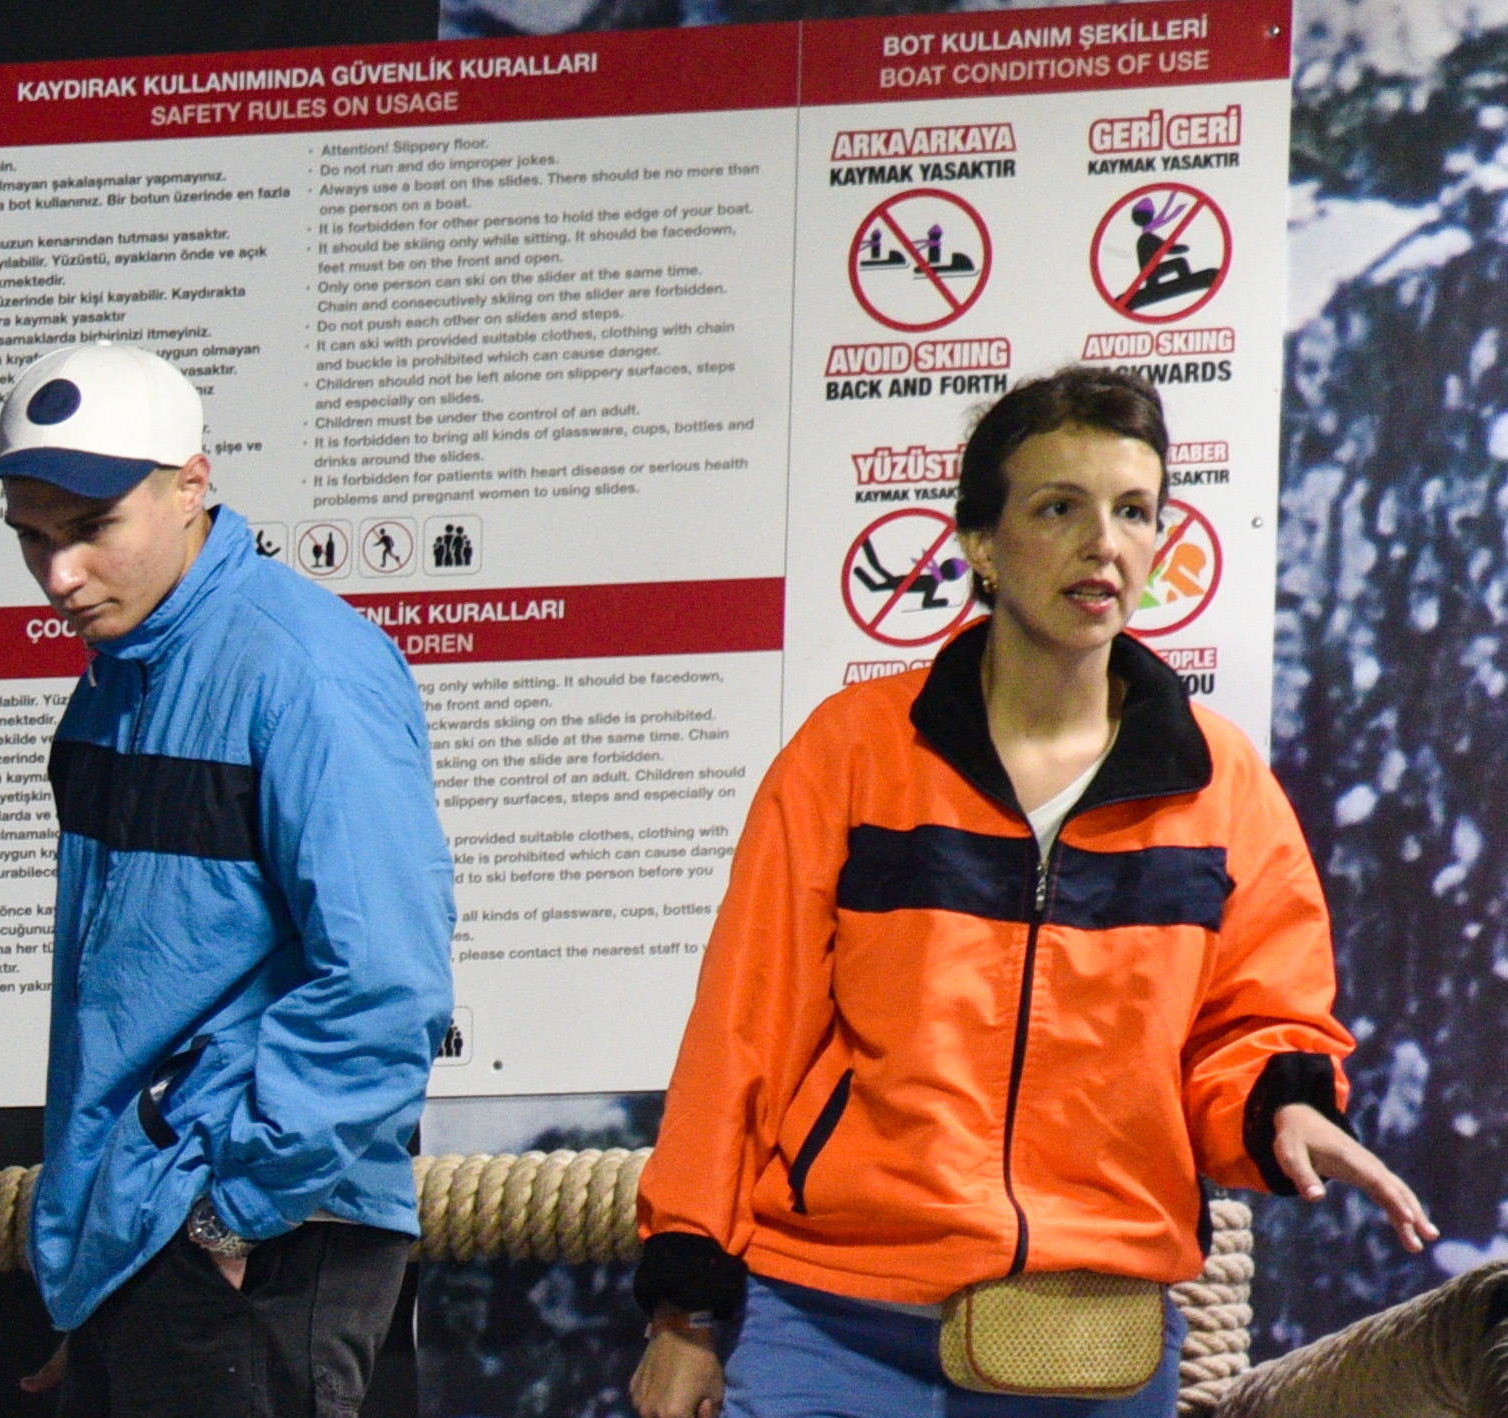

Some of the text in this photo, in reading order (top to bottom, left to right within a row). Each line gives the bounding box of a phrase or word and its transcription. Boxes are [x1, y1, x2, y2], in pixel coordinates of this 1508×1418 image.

[883, 13, 1208, 57] BOT KULLANIM ŞEKİLLERİ
[18, 53, 597, 102] KAYDIRAK KULLANIMINDA GÜVENLİK KURALLARI
[880, 50, 1209, 88] BOAT CONDITIONS OF USE
[151, 91, 458, 126] SAFETY RULES ON USAGE
[1089, 104, 1241, 154] GERİ GERİ
[321, 138, 488, 157] Attention! Slippery floor.
[831, 122, 1017, 161] ARKA ARKAYA
[320, 154, 558, 177] Do not run and do improper jokes.
[830, 159, 1016, 187] KAYMAK YASAKTIR
[1087, 152, 1239, 175] KAYMAK YASAKTIR
[51, 174, 142, 192] şakalaşmalar
[146, 172, 226, 188] yapmayınız.
[8, 198, 31, 211] bot
[35, 196, 102, 209] kullanınız.
[106, 193, 126, 206] Bir
[130, 193, 170, 205] botun
[173, 189, 233, 203] üzerinde
[237, 190, 254, 200] en
[258, 186, 291, 199] fazla
[37, 233, 114, 248] kenarından
[117, 232, 169, 244] tutması
[173, 228, 229, 245] yasaktır.
[52, 252, 110, 267] Yüzüstü,
[114, 251, 177, 266] ayakların
[180, 248, 215, 261] önde
[219, 249, 235, 259] ve
[238, 246, 267, 261] açık
[317, 308, 623, 333] Do not push each other on slides and steps.
[1082, 327, 1235, 360] AVOID SKIING
[825, 337, 1011, 377] AVOID SKIING
[826, 374, 1008, 401] BACK AND FORTH
[315, 404, 639, 430] Children must be under the control of an adult.
[1167, 441, 1229, 465] RABER
[1170, 469, 1229, 486] SAKTIR
[313, 482, 639, 509] problems and pregnant women to using slides.
[856, 486, 961, 503] KAYMAK YASAK
[429, 600, 564, 624] KURALLARI
[395, 633, 473, 655] LDREN
[1156, 648, 1217, 670] EOPLE
[454, 825, 729, 848] provided suitable clothes, clothing with
[16, 943, 38, 954] her
[459, 942, 698, 963] please contact the nearest staff to
